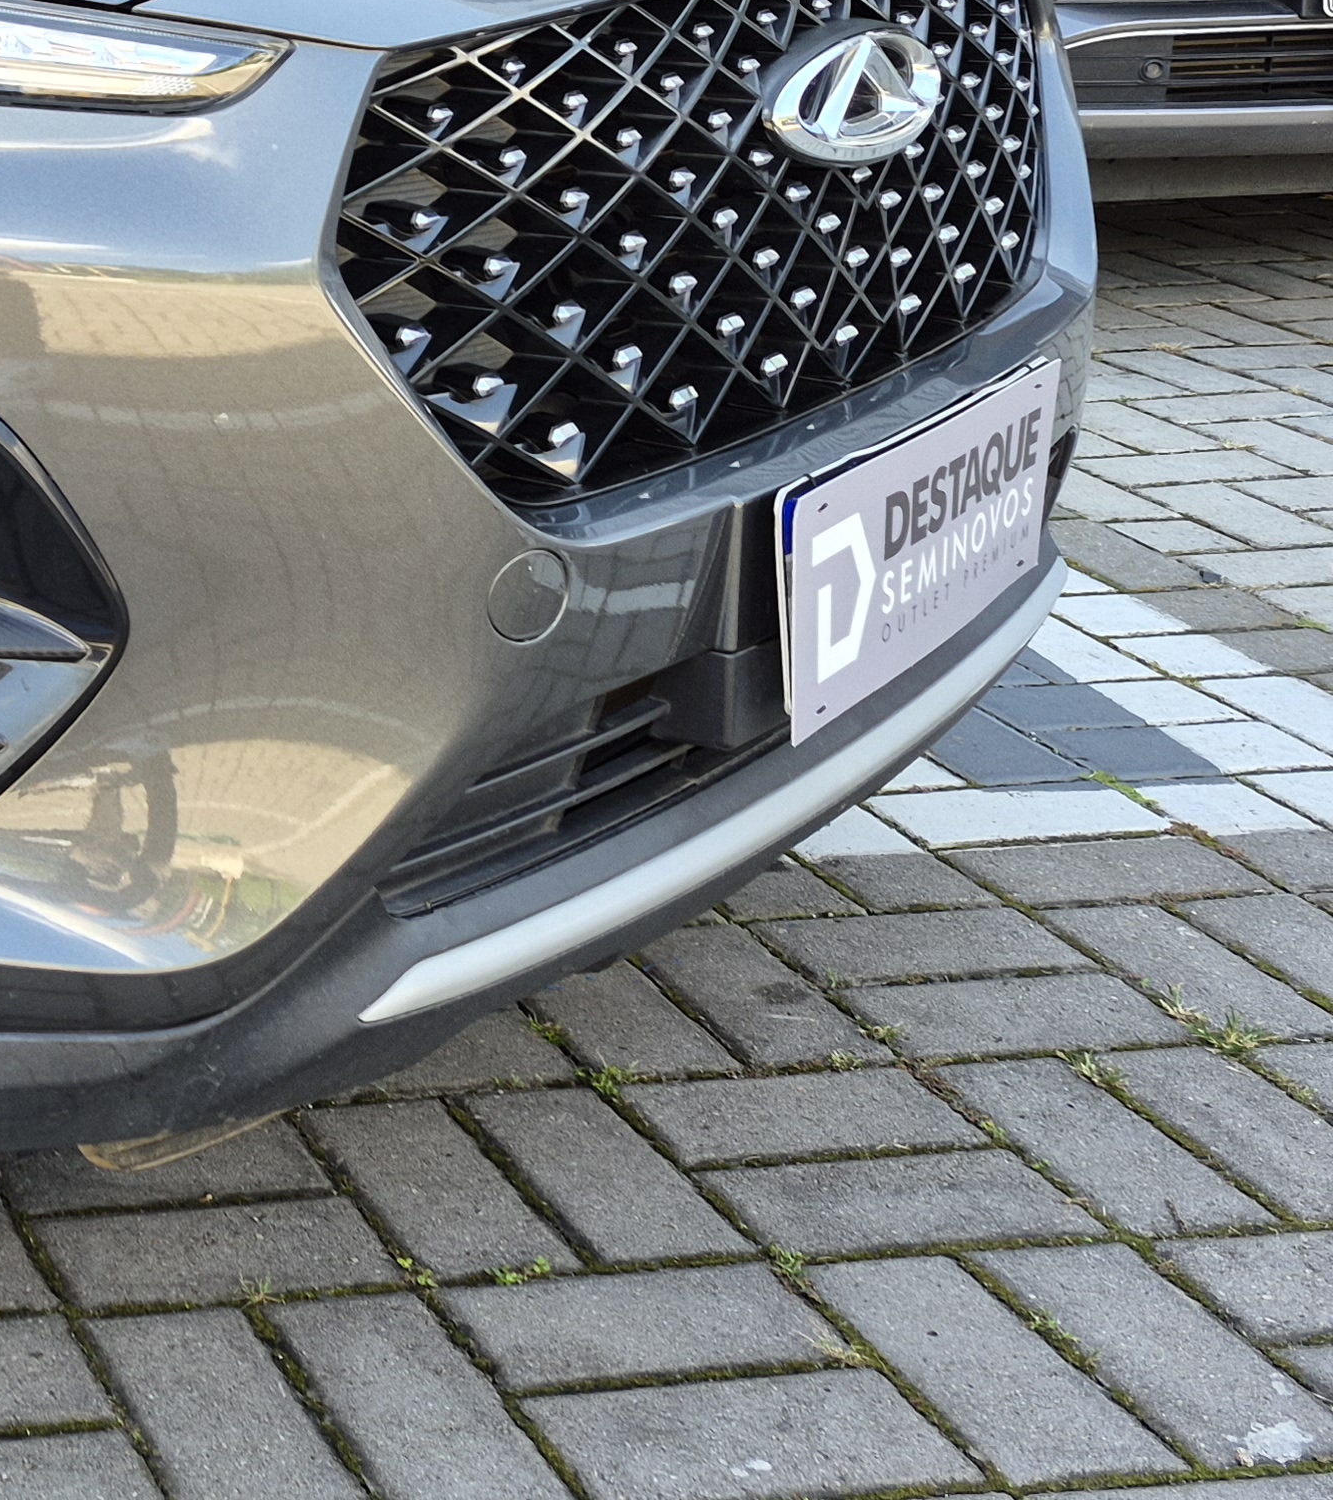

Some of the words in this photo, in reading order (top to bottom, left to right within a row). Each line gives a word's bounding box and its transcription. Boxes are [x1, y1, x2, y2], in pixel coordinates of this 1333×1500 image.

[881, 476, 1034, 615] SEMINOVOS
[883, 406, 1042, 562] DESTAQUE
[881, 582, 950, 643] OUTLET
[963, 522, 1030, 589] PREMIUM
